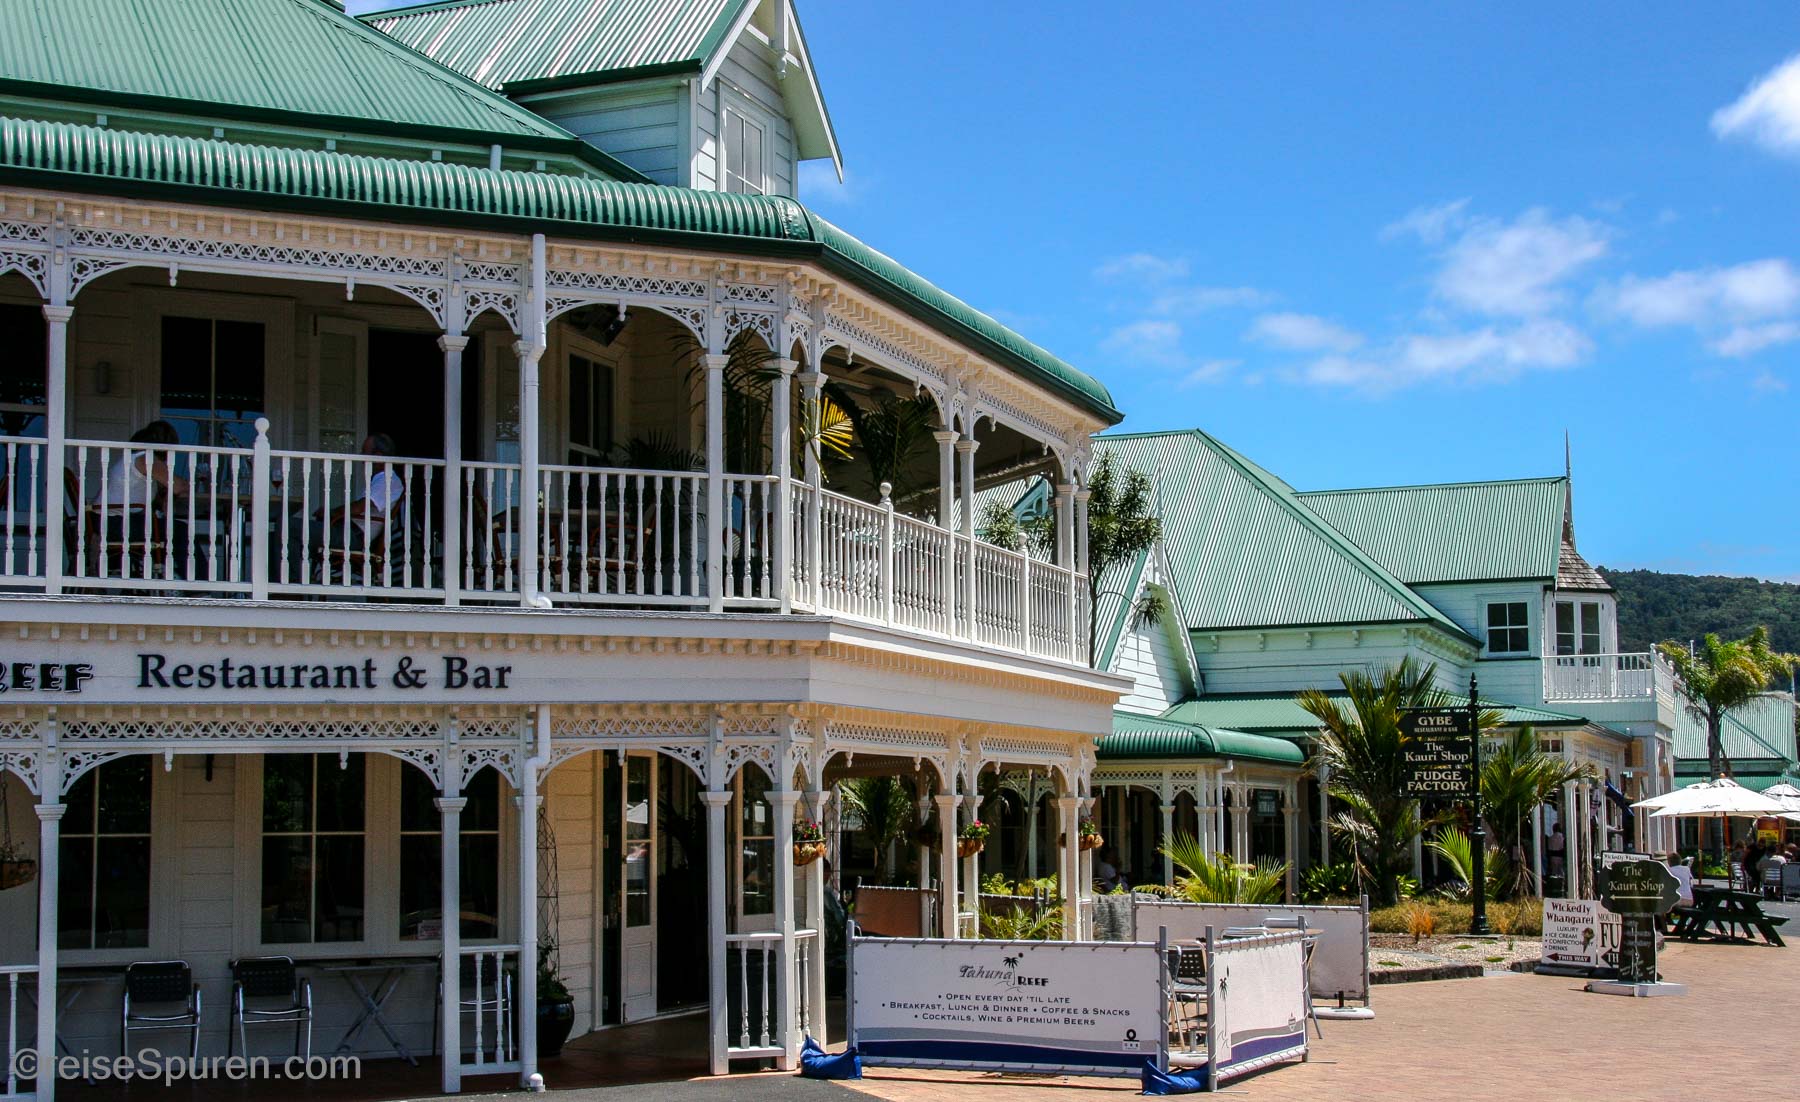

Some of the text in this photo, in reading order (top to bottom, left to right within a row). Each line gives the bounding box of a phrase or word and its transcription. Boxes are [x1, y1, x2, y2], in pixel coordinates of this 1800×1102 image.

[136, 653, 378, 689] Restaurant
[392, 655, 428, 689] &
[442, 656, 513, 690] Bar
[1417, 716, 1454, 726] GYBE
[1423, 742, 1445, 751] The
[1404, 752, 1437, 762] Kauri
[1441, 751, 1469, 763] Shop
[1413, 771, 1462, 781] FUDGE
[1407, 781, 1469, 791] FACTORY
[1621, 864, 1643, 877] The
[1608, 878, 1665, 895] Kauri Shop
[1600, 923, 1622, 948] FU
[958, 965, 1049, 987] Tahuna REEF
[945, 993, 972, 1001] OPEN
[975, 994, 1004, 1002] EVERY
[889, 1001, 1131, 1017] BREAKFAST, LUNCH & DINNER COFFEE & SNACKS
[922, 1012, 1096, 1026] COCKTAILS, WINE & PREMIUM BEERS
